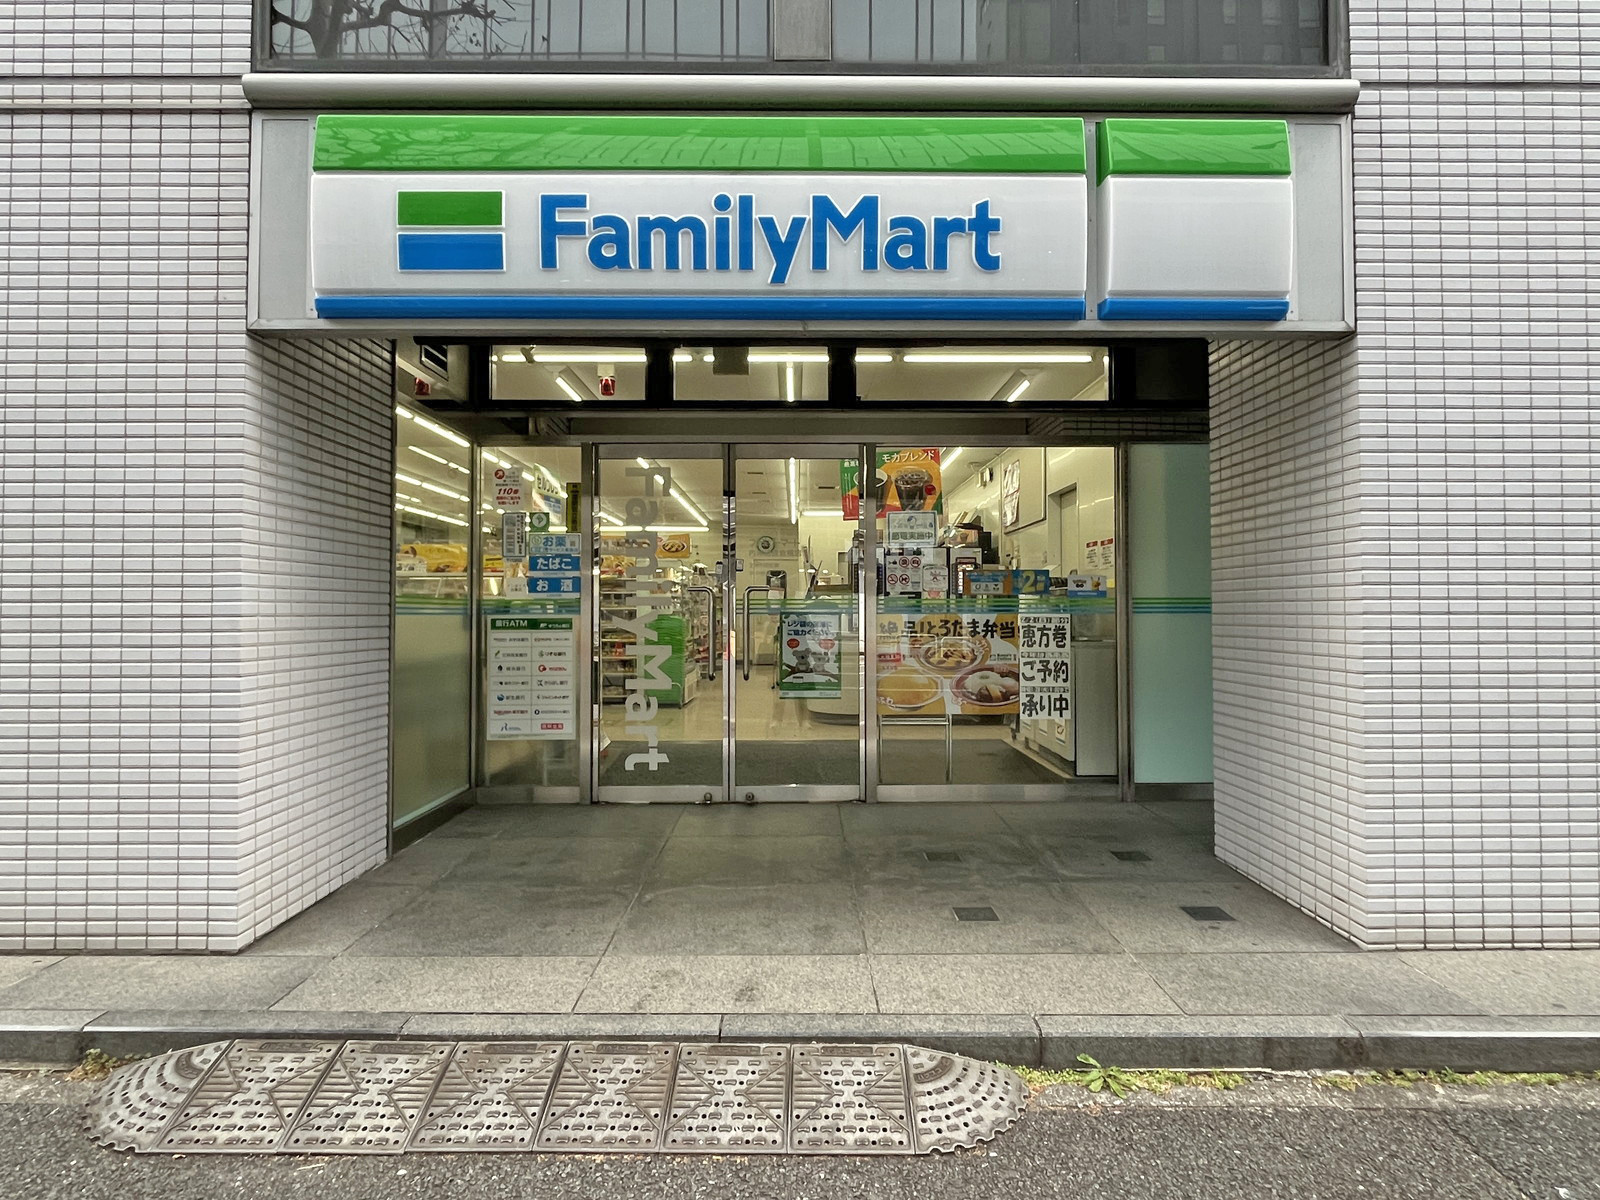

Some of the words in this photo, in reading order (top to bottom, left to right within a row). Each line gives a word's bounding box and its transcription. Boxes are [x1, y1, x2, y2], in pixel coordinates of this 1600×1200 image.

[539, 193, 1002, 285] FamilyMart
[882, 450, 935, 464] モカブレンド
[536, 557, 572, 570] たばこ
[611, 467, 673, 772] FamilyMart
[1021, 624, 1068, 649] 恵方巻
[1021, 659, 1069, 684] ご予約
[1021, 693, 1069, 718] 承り中
